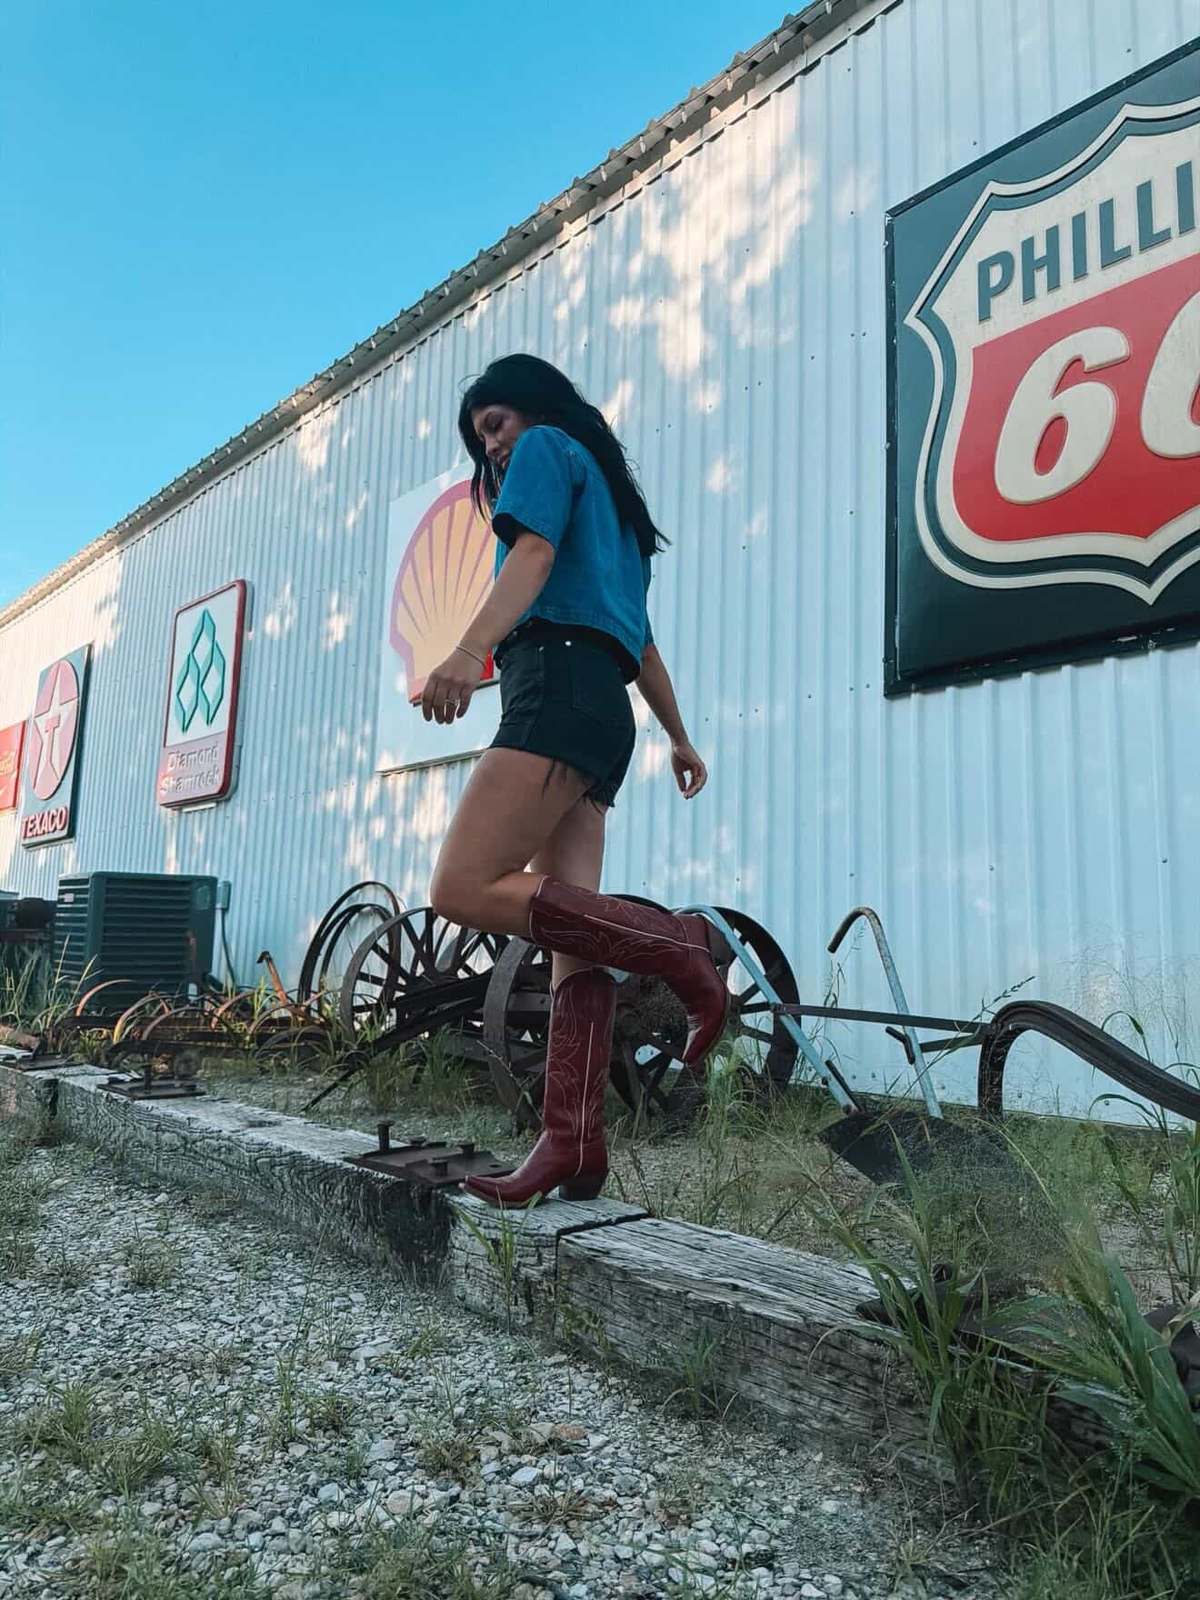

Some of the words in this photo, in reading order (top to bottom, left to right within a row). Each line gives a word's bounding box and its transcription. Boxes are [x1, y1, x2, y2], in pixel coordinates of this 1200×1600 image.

[978, 160, 1197, 324] PHILLI
[167, 743, 218, 770] Diamond
[160, 765, 219, 792] Shamrock
[22, 806, 68, 839] TEXACO
